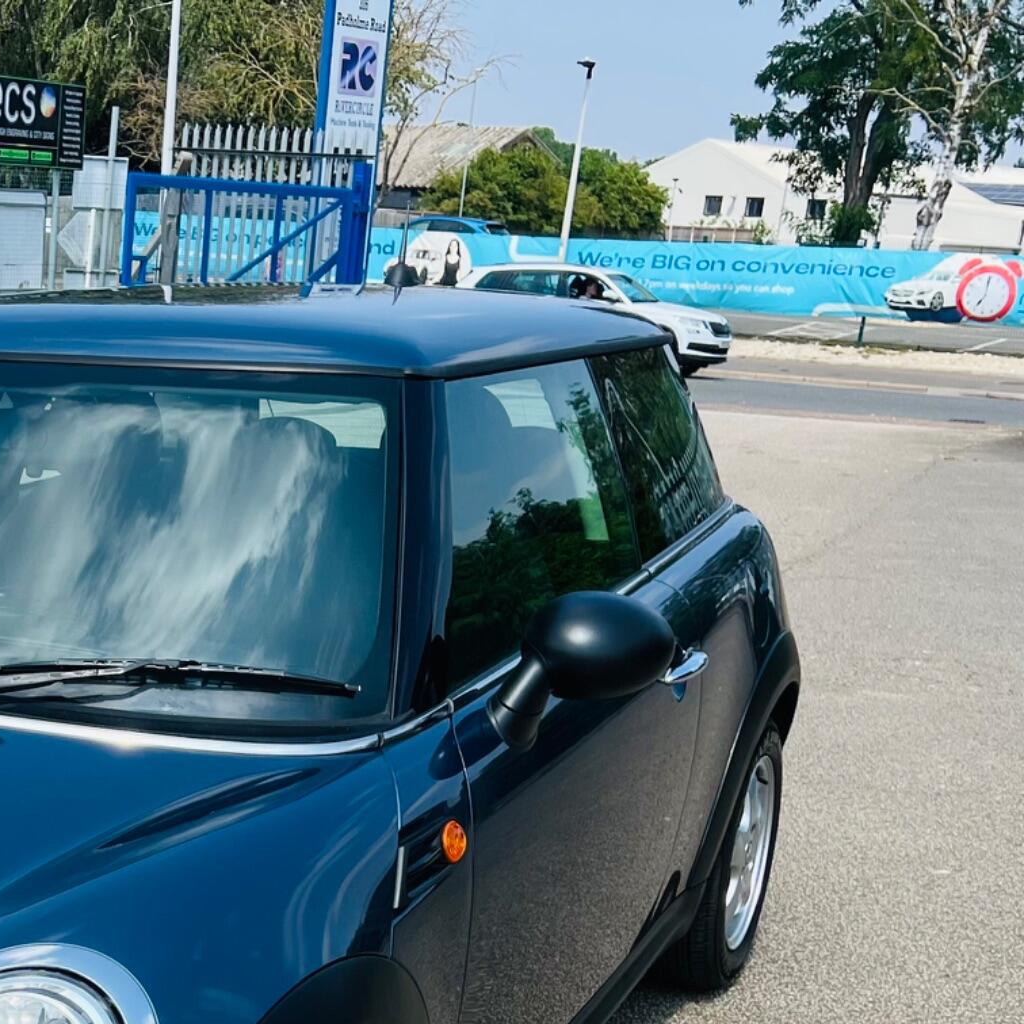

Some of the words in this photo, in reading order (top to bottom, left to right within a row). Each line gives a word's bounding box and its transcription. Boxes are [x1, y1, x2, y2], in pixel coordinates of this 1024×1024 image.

[370, 17, 386, 33] Road
[577, 251, 645, 268] We're
[651, 254, 691, 271] BIG
[696, 260, 725, 272] on
[732, 259, 896, 279] convenience
[679, 279, 721, 292] weekdays
[734, 282, 752, 293] you
[754, 284, 770, 293] can
[771, 283, 794, 296] shop
